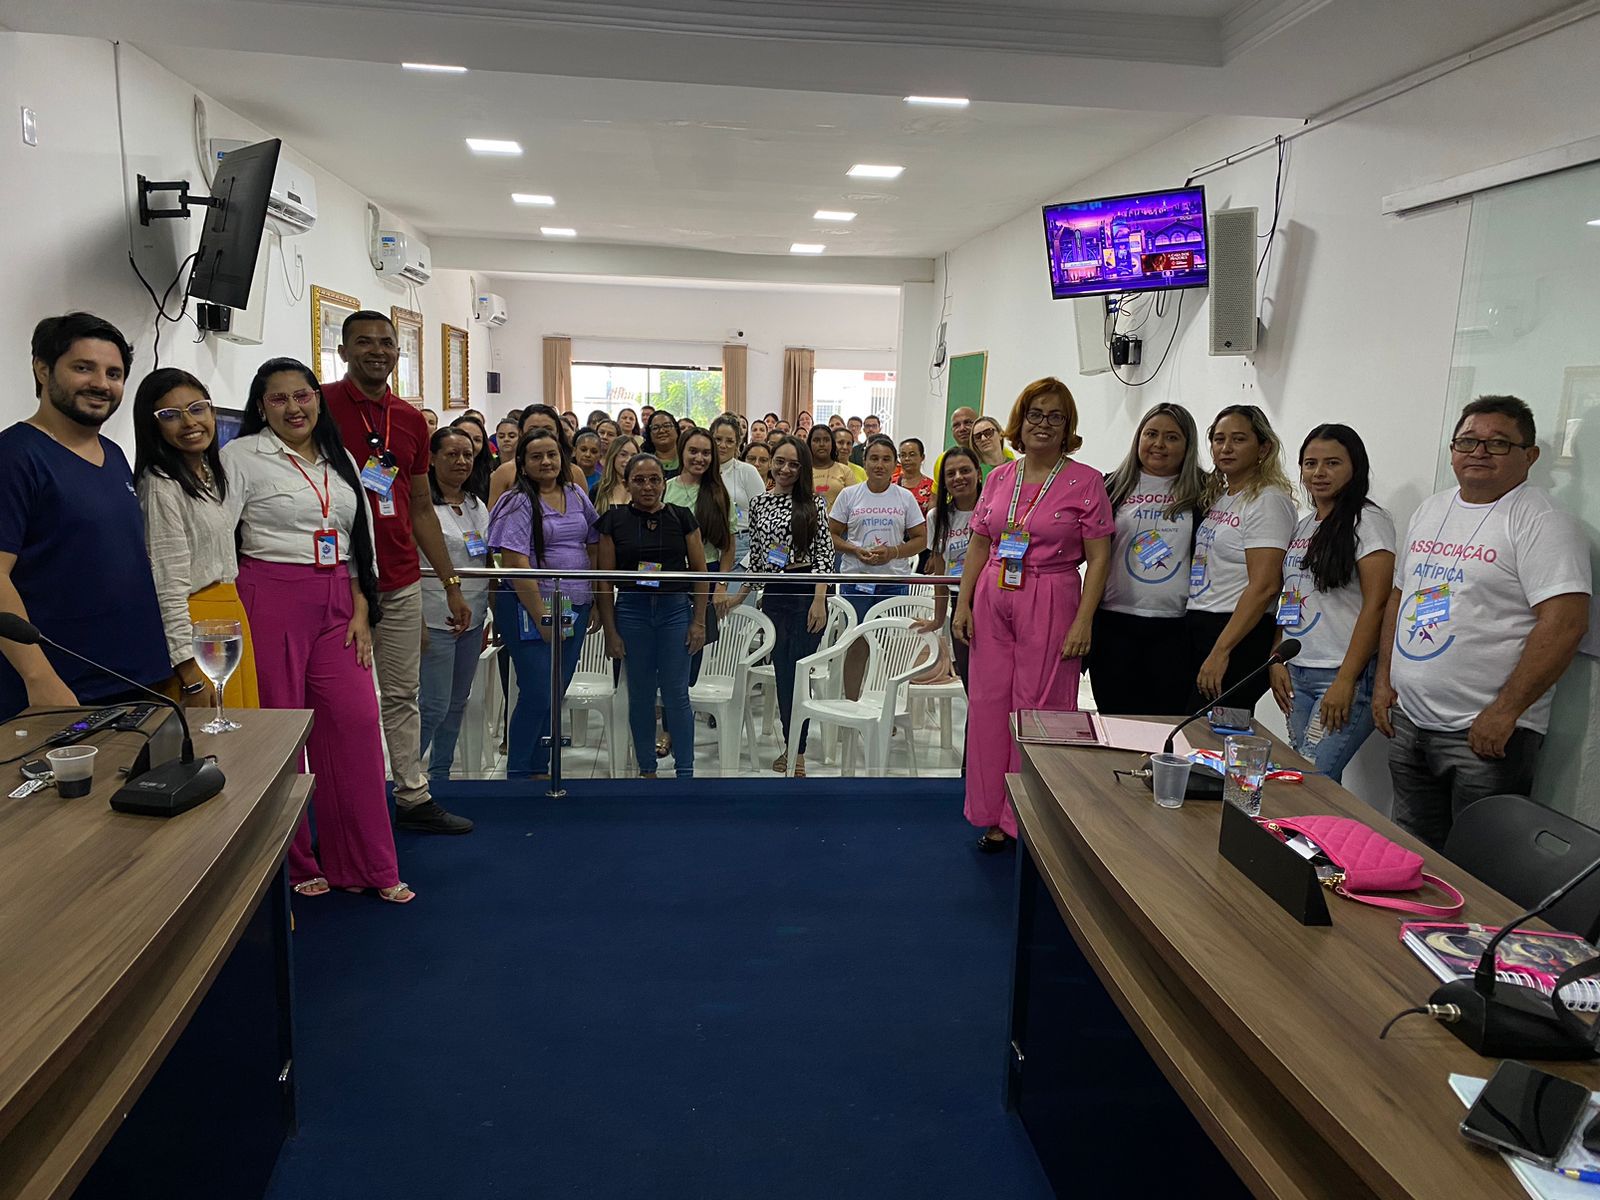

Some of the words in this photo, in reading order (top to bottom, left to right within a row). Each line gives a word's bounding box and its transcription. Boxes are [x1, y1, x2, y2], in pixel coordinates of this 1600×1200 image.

[851, 507, 905, 516] ASSOCIAÇÃO
[862, 517, 893, 526] ATÍPICA
[1410, 540, 1497, 563] ASSOCIAÇÃO
[1413, 563, 1464, 583] ATÍPICA
